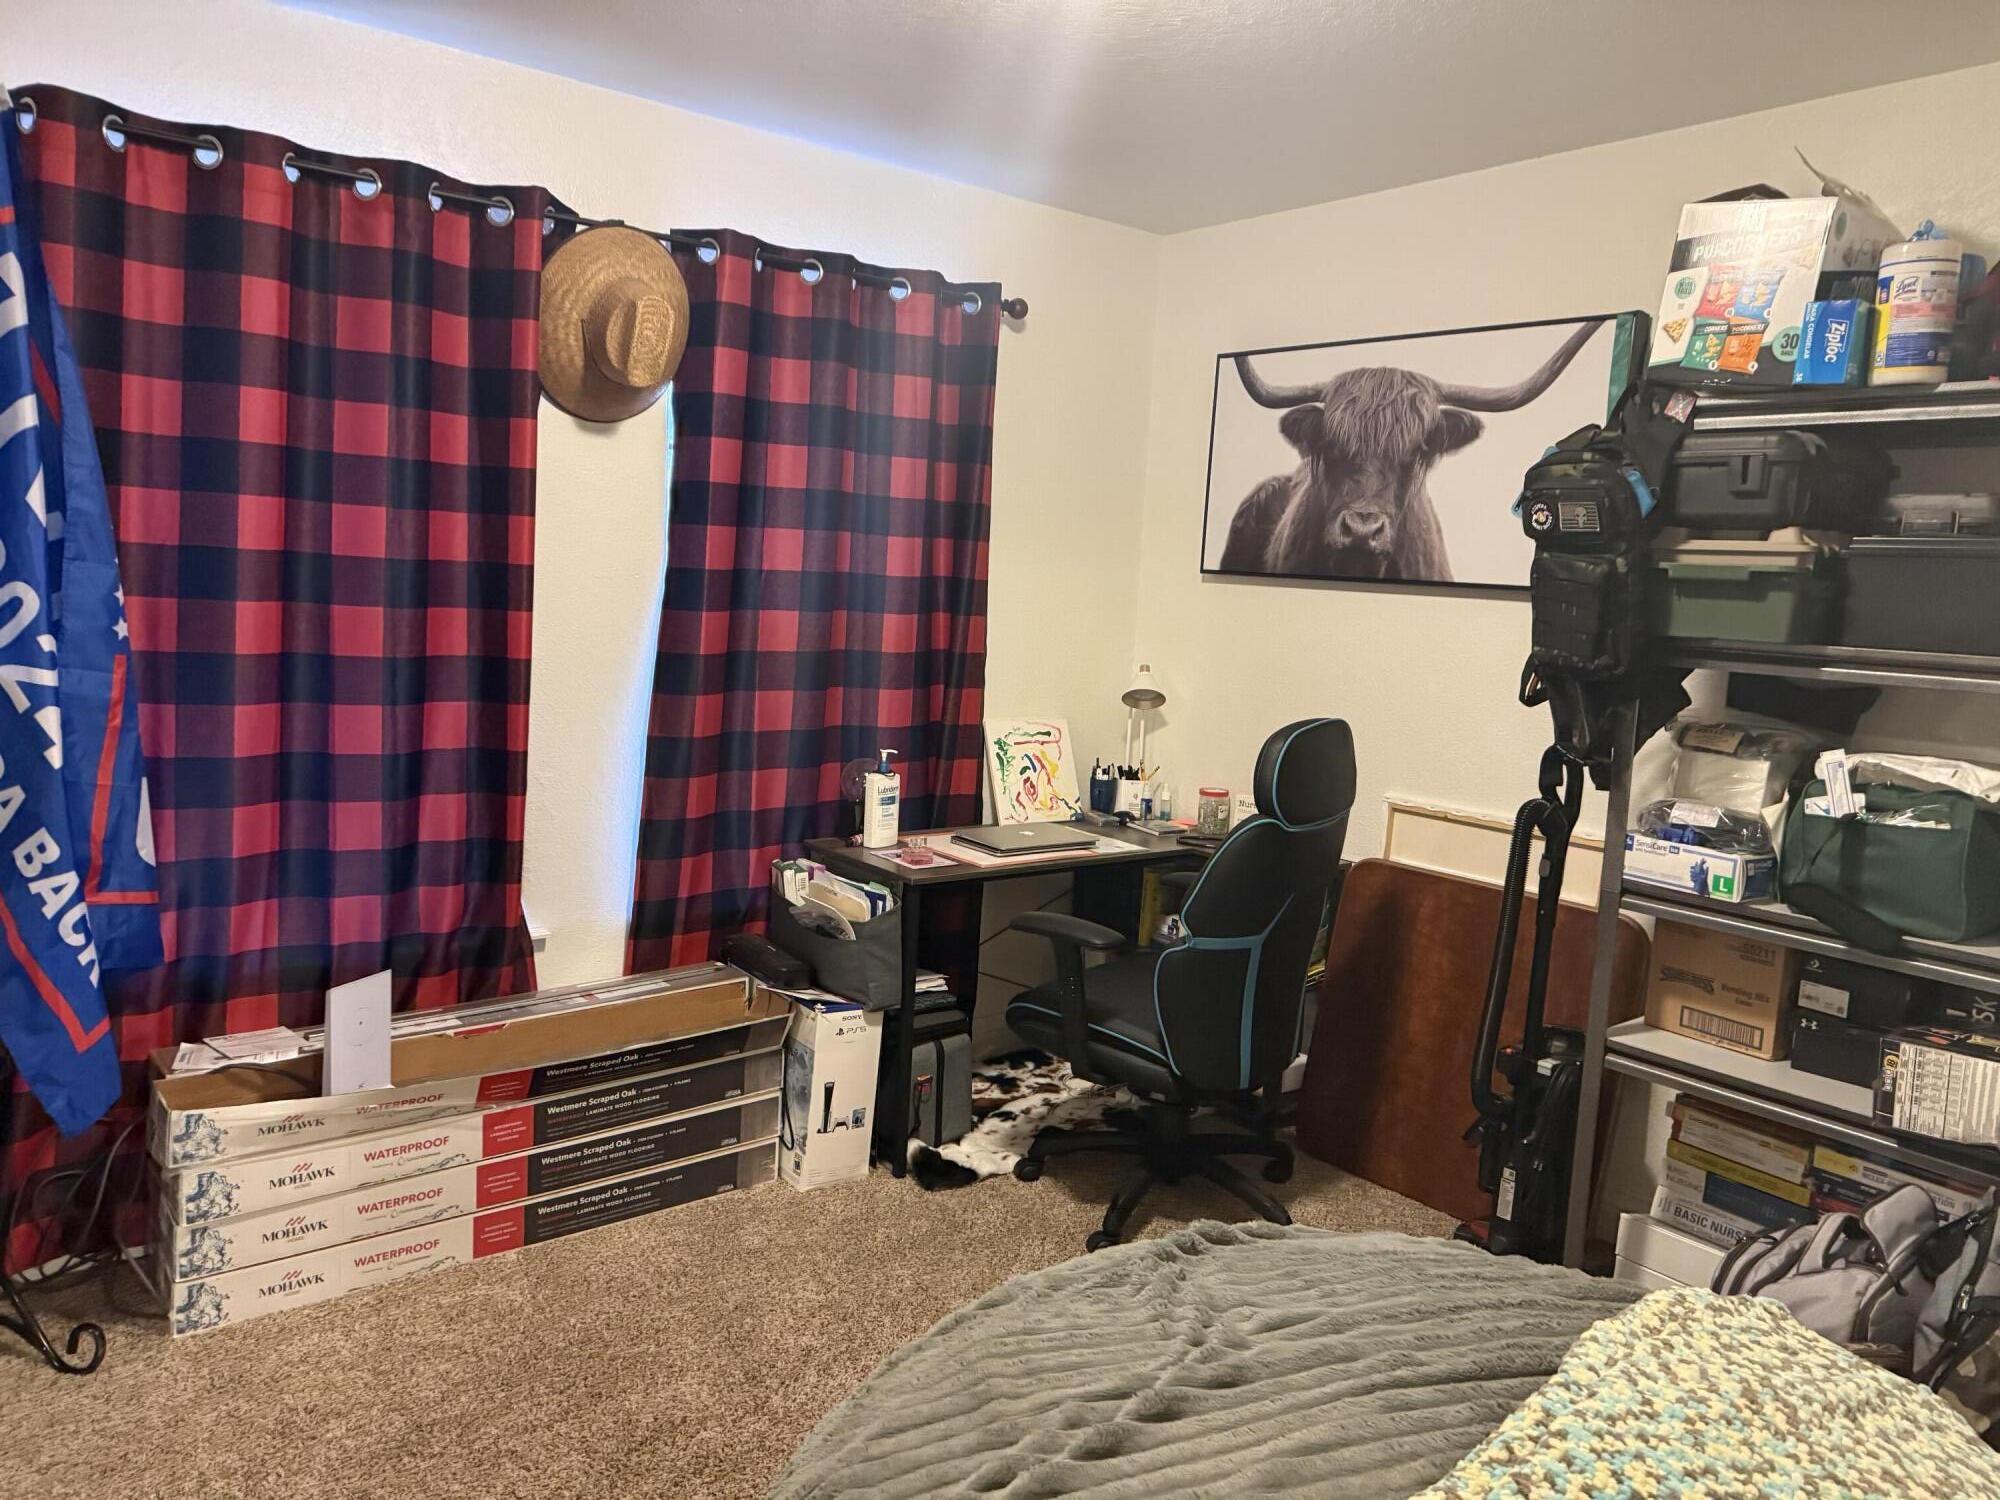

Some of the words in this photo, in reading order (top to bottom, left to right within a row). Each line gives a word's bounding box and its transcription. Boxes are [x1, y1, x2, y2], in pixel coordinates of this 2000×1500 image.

[1780, 333, 1800, 350] 30
[1824, 322, 1847, 363] Ziploc
[1636, 839, 1668, 852] SensiCare
[1719, 877, 1728, 892] L
[842, 1014, 862, 1022] SONY
[846, 1026, 867, 1034] PS5
[546, 1064, 588, 1077] Westmere
[589, 1056, 622, 1069] Scraped
[623, 1053, 639, 1063] Oak
[356, 1093, 446, 1115] WATERPROOF
[547, 1100, 588, 1115] Westmere
[589, 1091, 621, 1106] Scraped
[621, 1088, 637, 1098] Oak
[585, 1105, 614, 1116] LAMINATE
[614, 1101, 632, 1110] WOOD
[257, 1117, 326, 1137] MOHAWK
[363, 1135, 451, 1163] WATERPROOF
[541, 1150, 582, 1166] Westmere
[583, 1141, 615, 1157] Scraped
[615, 1137, 632, 1148] Oak
[269, 1166, 337, 1190] MOHAWK
[357, 1187, 444, 1215] WATERPROOF
[537, 1199, 579, 1216] Westmere
[579, 1190, 611, 1206] Scraped
[612, 1186, 629, 1197] Oak
[1674, 1206, 1708, 1229] BASIC
[261, 1219, 329, 1244] MOHAWK
[353, 1239, 442, 1268] WATERPROOF
[258, 1273, 326, 1299] MOHAWK
